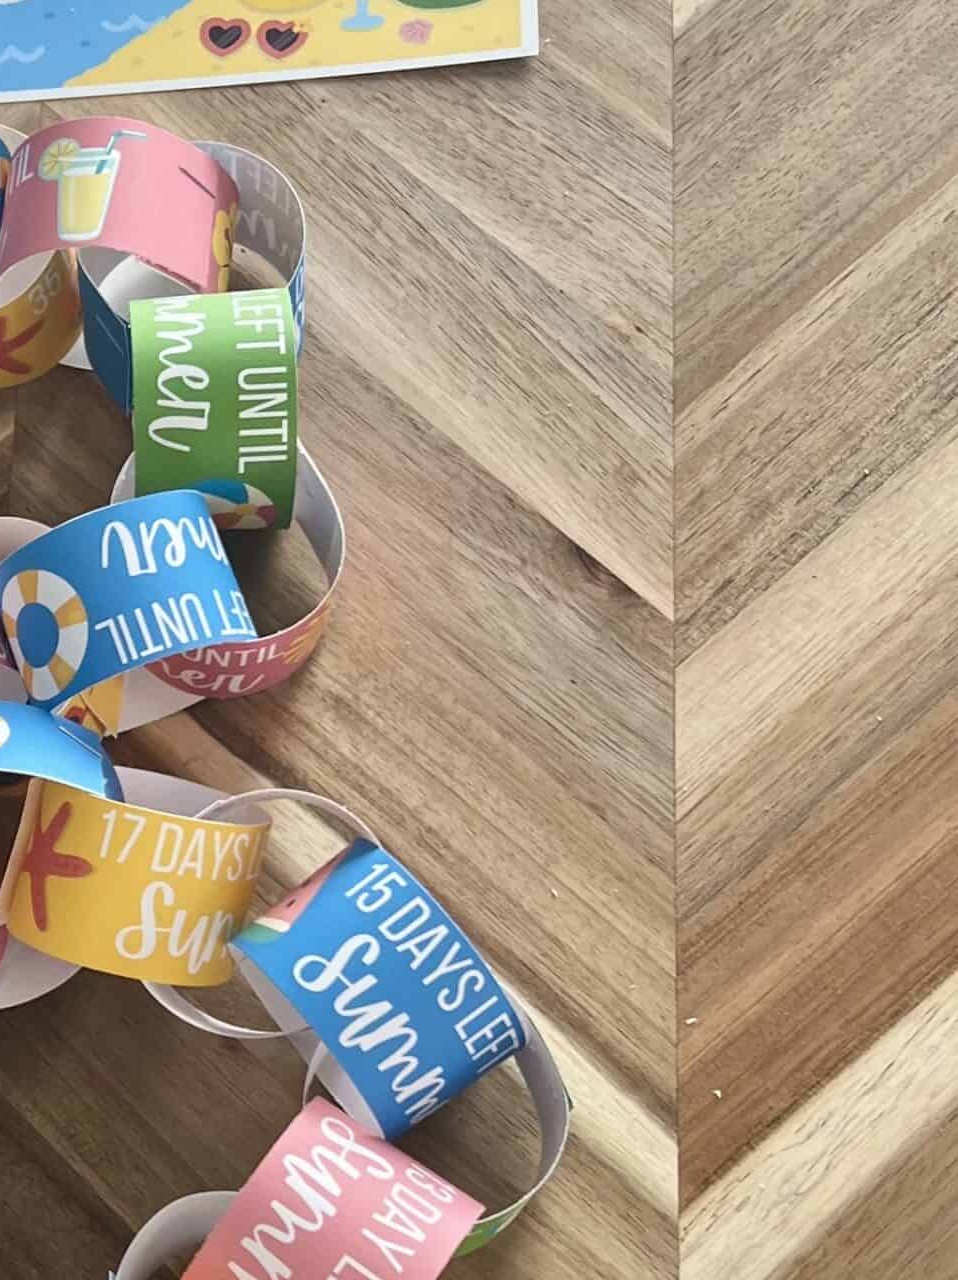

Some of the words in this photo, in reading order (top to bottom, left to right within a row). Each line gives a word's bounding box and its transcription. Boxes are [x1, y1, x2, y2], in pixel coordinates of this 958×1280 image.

[232, 293, 287, 356] LEFT
[147, 296, 211, 453] mmer
[237, 365, 289, 475] UNTIL
[100, 516, 230, 578] mer
[94, 592, 213, 666] UNTIL
[213, 590, 259, 638] EFT
[98, 808, 147, 865] 17
[149, 820, 250, 882] DAYS
[345, 862, 409, 914] 15
[377, 896, 486, 1013] DAYS
[292, 933, 447, 1126] Summ
[360, 1182, 444, 1274] DAY
